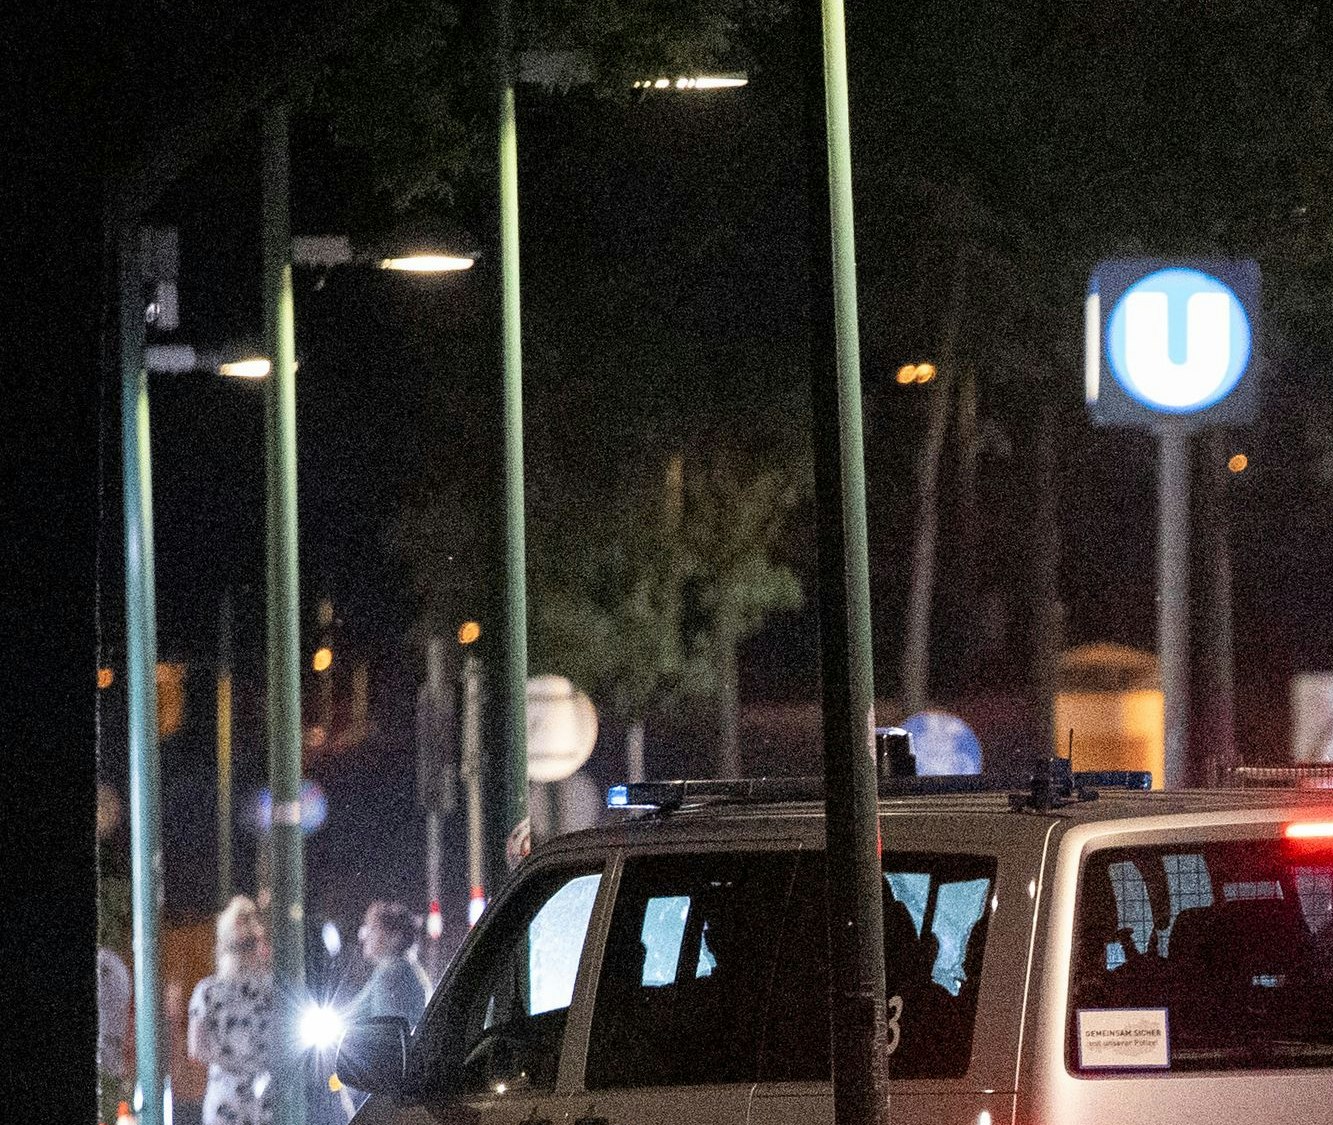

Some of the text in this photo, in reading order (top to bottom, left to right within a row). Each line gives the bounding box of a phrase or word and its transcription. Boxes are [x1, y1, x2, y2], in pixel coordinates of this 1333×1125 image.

[1125, 291, 1230, 407] U
[1085, 1029, 1162, 1038] GEMEINSAM SICHER
